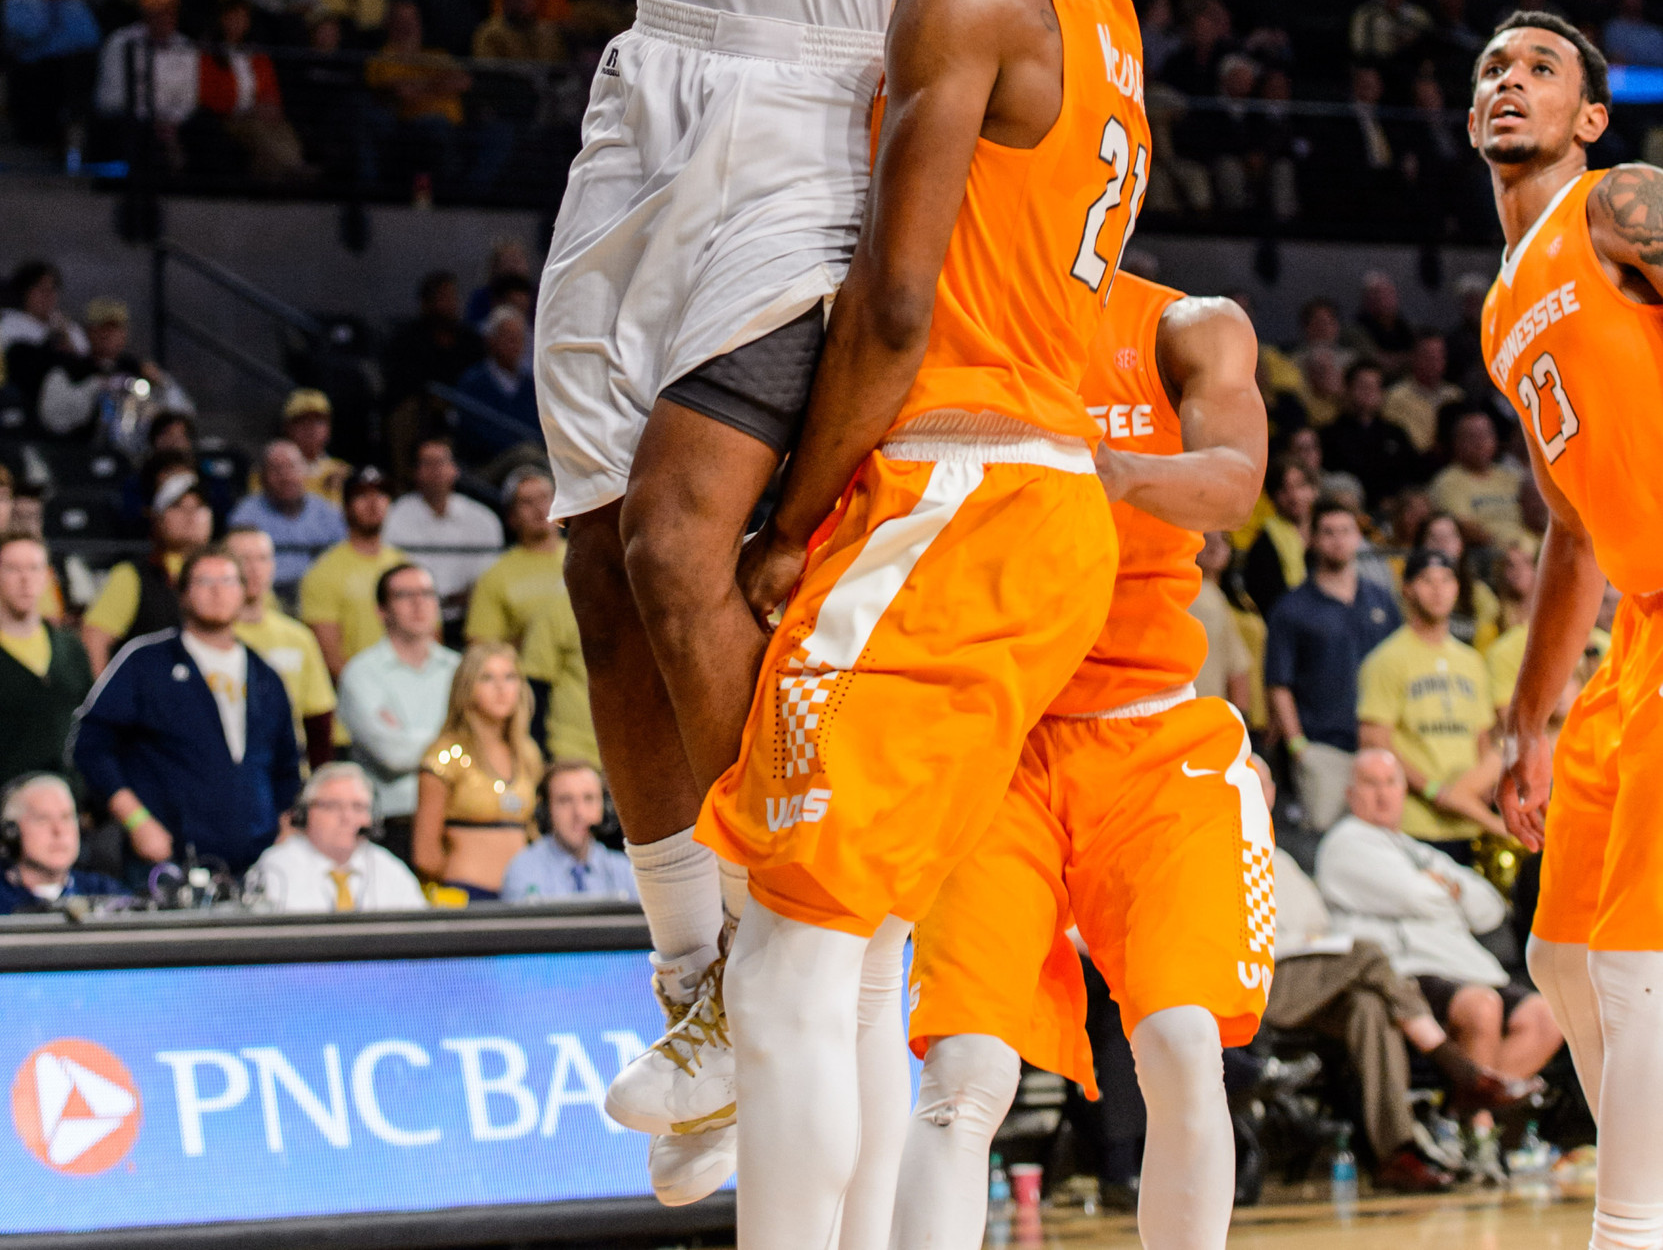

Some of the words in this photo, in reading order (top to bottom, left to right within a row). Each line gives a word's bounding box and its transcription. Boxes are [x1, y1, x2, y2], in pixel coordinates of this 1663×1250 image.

[1070, 114, 1150, 308] 21
[1490, 281, 1581, 390] TENNESSEE
[1518, 351, 1580, 465] 23
[156, 1043, 443, 1157] PNC
